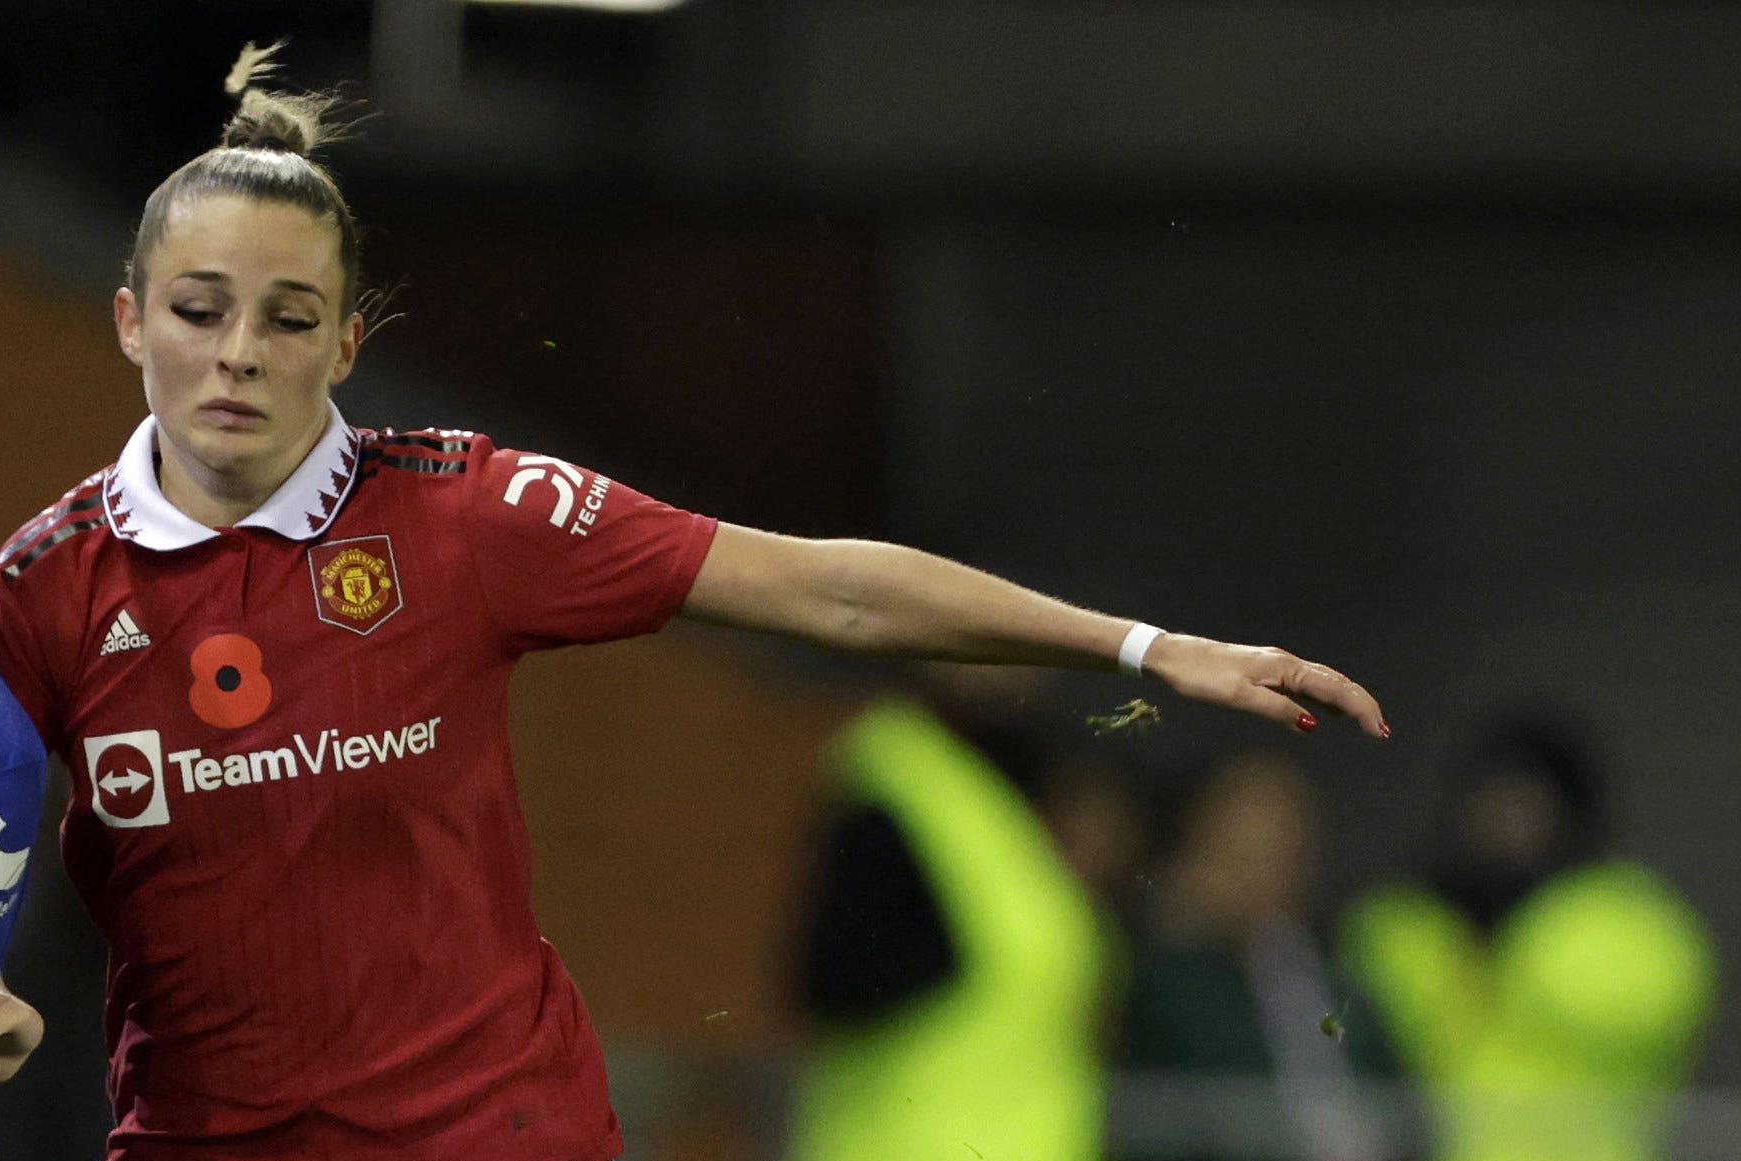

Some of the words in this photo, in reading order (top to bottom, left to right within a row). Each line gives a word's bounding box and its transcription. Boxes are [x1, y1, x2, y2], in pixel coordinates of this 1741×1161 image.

[569, 474, 611, 537] TECHN
[341, 599, 380, 614] UNITED
[100, 632, 151, 656] adidas
[167, 716, 441, 793] TeamViewer
